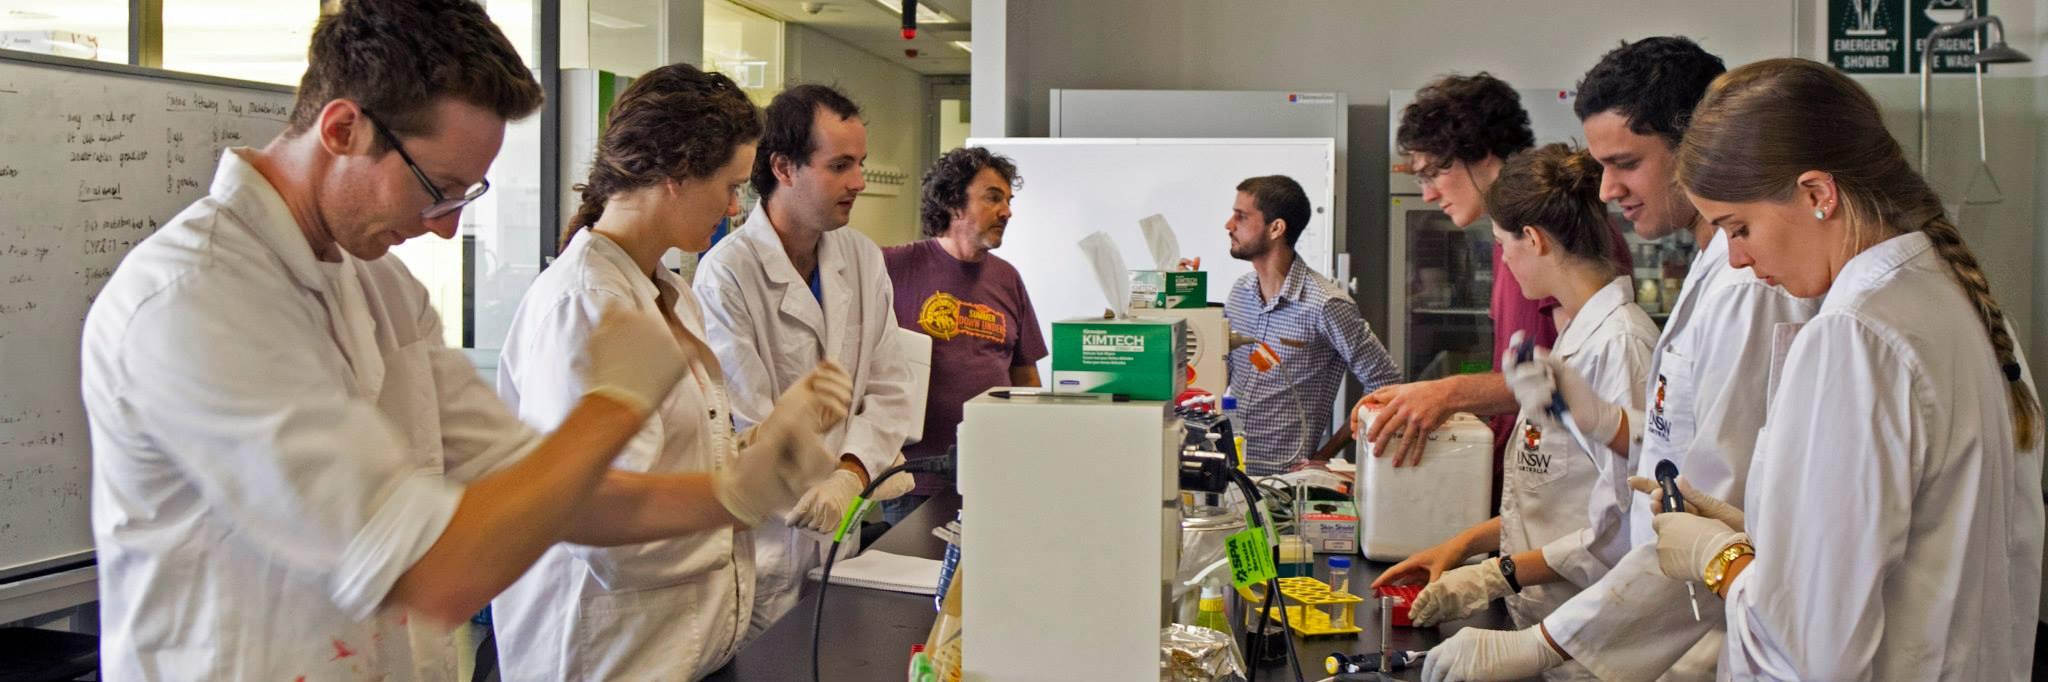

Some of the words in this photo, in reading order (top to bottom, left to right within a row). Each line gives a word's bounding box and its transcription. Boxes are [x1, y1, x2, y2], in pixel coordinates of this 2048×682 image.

[1834, 39, 1899, 52] EMERGENCY
[1916, 39, 1977, 52] ERGENC
[1843, 55, 1889, 68] SHOWER
[968, 308, 996, 323] SUMMER
[1083, 334, 1144, 345] KIMTECH
[1517, 450, 1552, 468] UNSW
[1228, 538, 1243, 568] SPA
